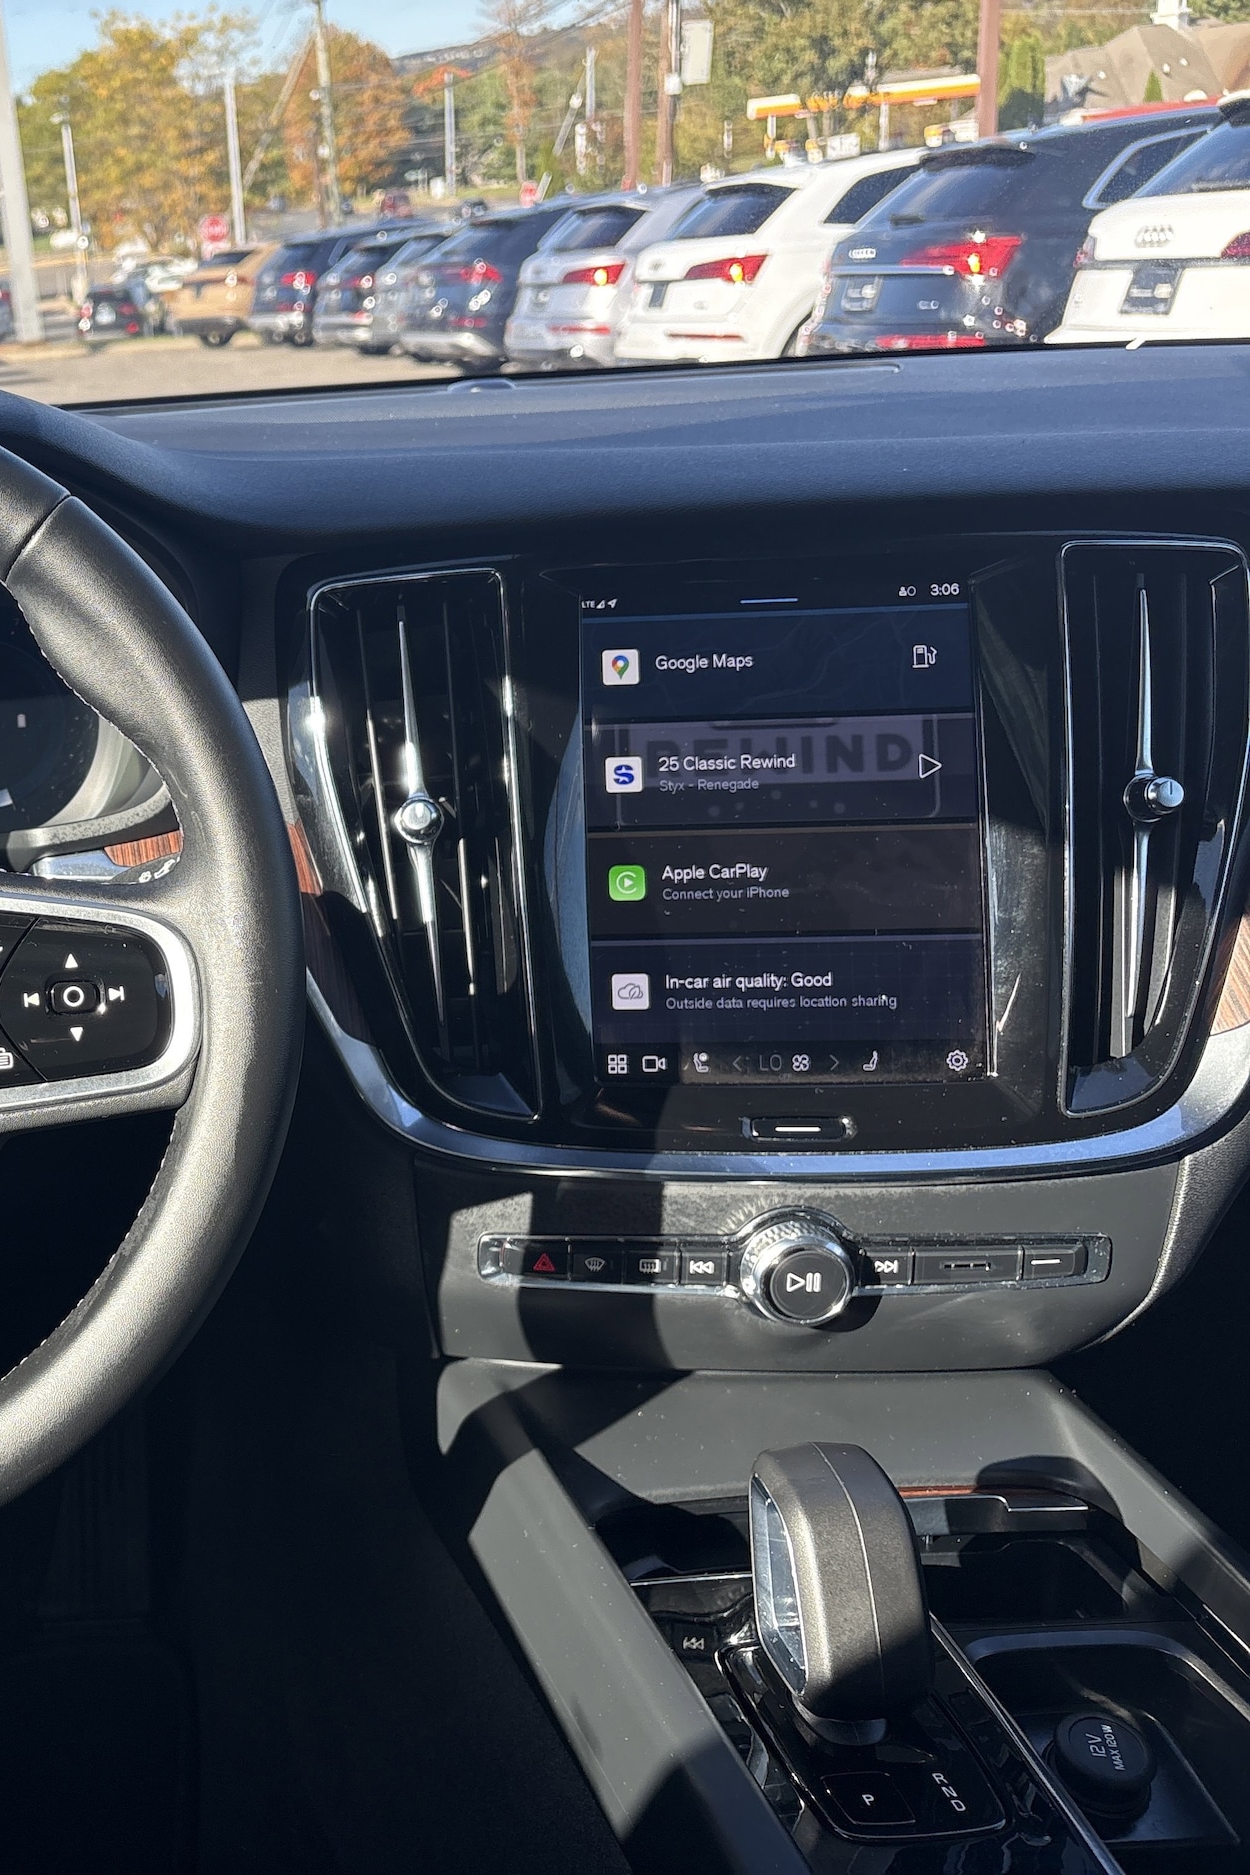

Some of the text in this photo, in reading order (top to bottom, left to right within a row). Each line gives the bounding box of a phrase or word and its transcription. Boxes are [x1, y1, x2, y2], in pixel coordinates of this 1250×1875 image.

[930, 583, 960, 596] 3:06
[581, 600, 596, 609] LTE
[655, 653, 754, 673] Google Maps
[658, 753, 796, 772] 25 Classic Rewind
[659, 780, 685, 794] Styx
[697, 778, 759, 793] Renegade
[662, 863, 768, 883] Apple CarPlay
[662, 886, 790, 902] Connect your iPhone
[665, 972, 832, 991] In-car air quality: Good
[665, 994, 898, 1011] Outside data requires location sharing
[1085, 1732, 1107, 1758] 12V
[1109, 1749, 1126, 1771] MAX
[932, 1772, 949, 1785] R
[861, 1793, 875, 1806] P
[941, 1785, 958, 1798] N
[950, 1799, 967, 1812] D
